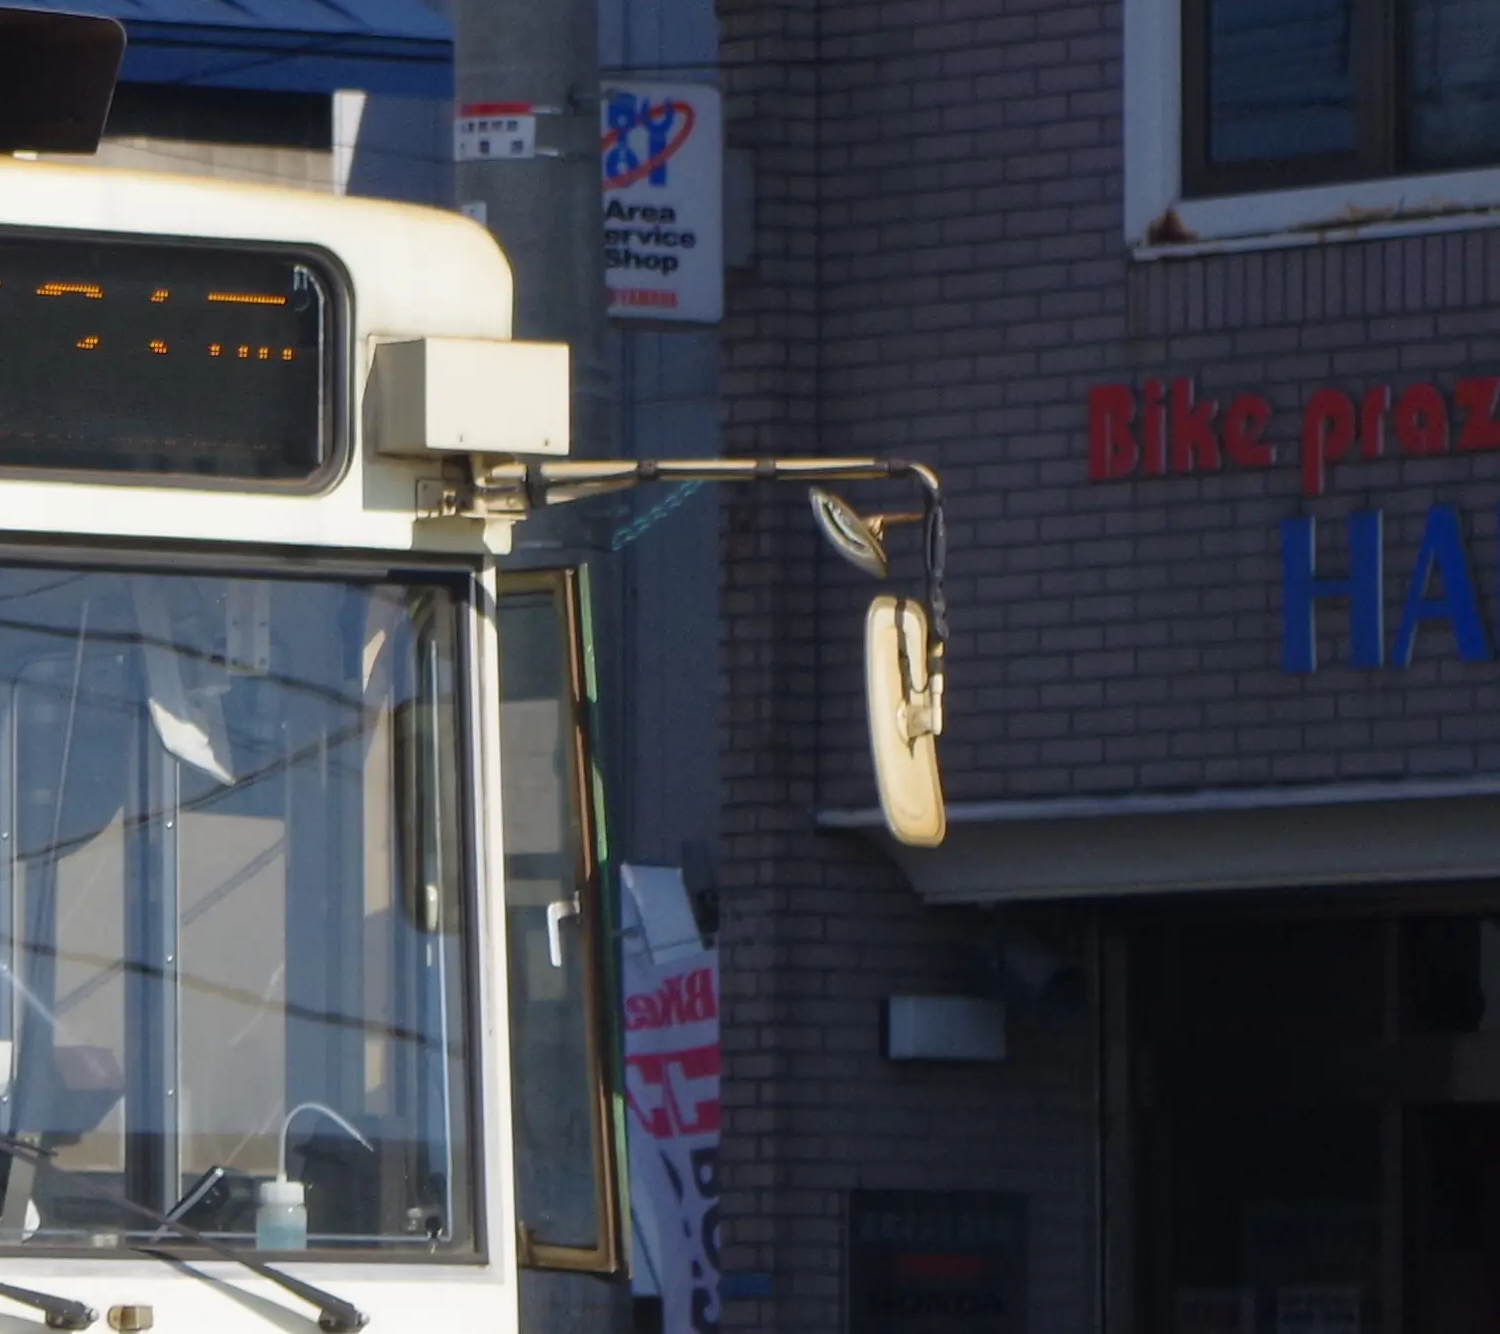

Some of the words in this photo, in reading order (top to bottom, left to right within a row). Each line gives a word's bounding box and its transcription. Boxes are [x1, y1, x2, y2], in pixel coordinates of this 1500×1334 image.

[604, 225, 695, 249] ervice
[605, 200, 676, 224] Area
[1088, 377, 1278, 481] Bike
[1280, 503, 1500, 673] HA
